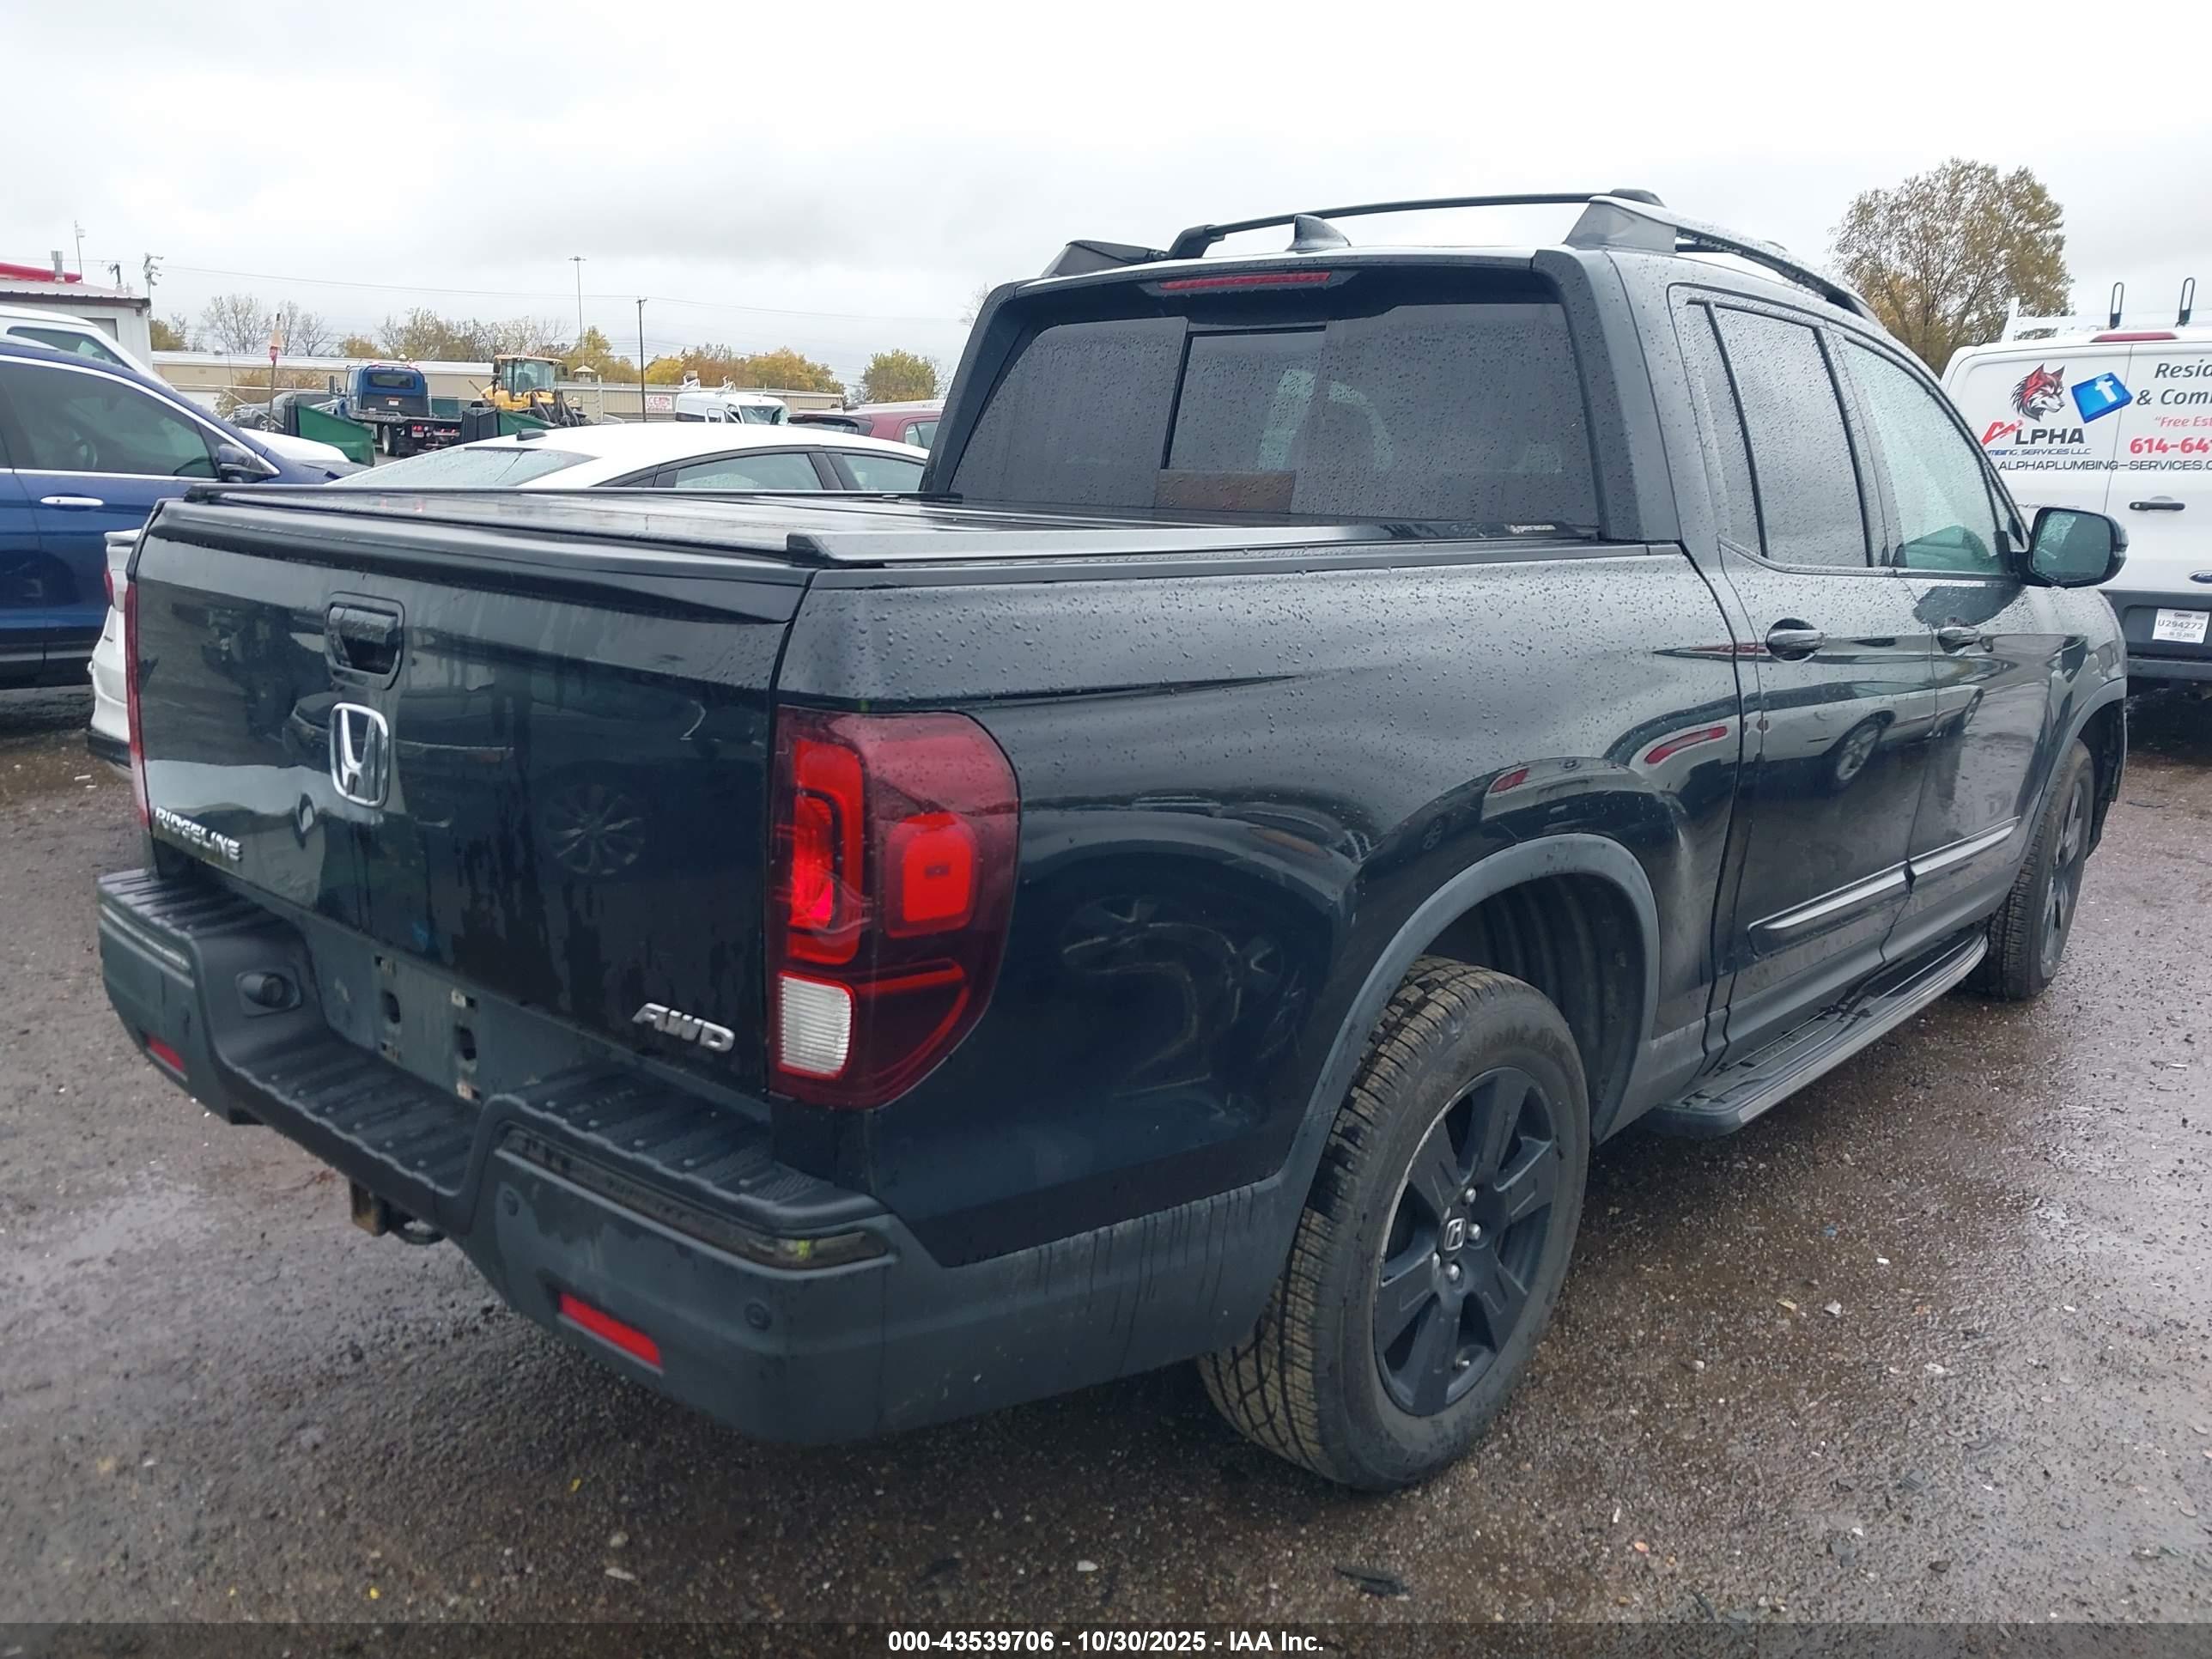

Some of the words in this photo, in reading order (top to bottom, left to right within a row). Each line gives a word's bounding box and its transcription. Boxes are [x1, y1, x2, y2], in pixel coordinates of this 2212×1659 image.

[2136, 390, 2153, 405] &
[2160, 389, 2212, 404] Com
[155, 806, 243, 861] RIDGELINE
[632, 1002, 736, 1053] AWD
